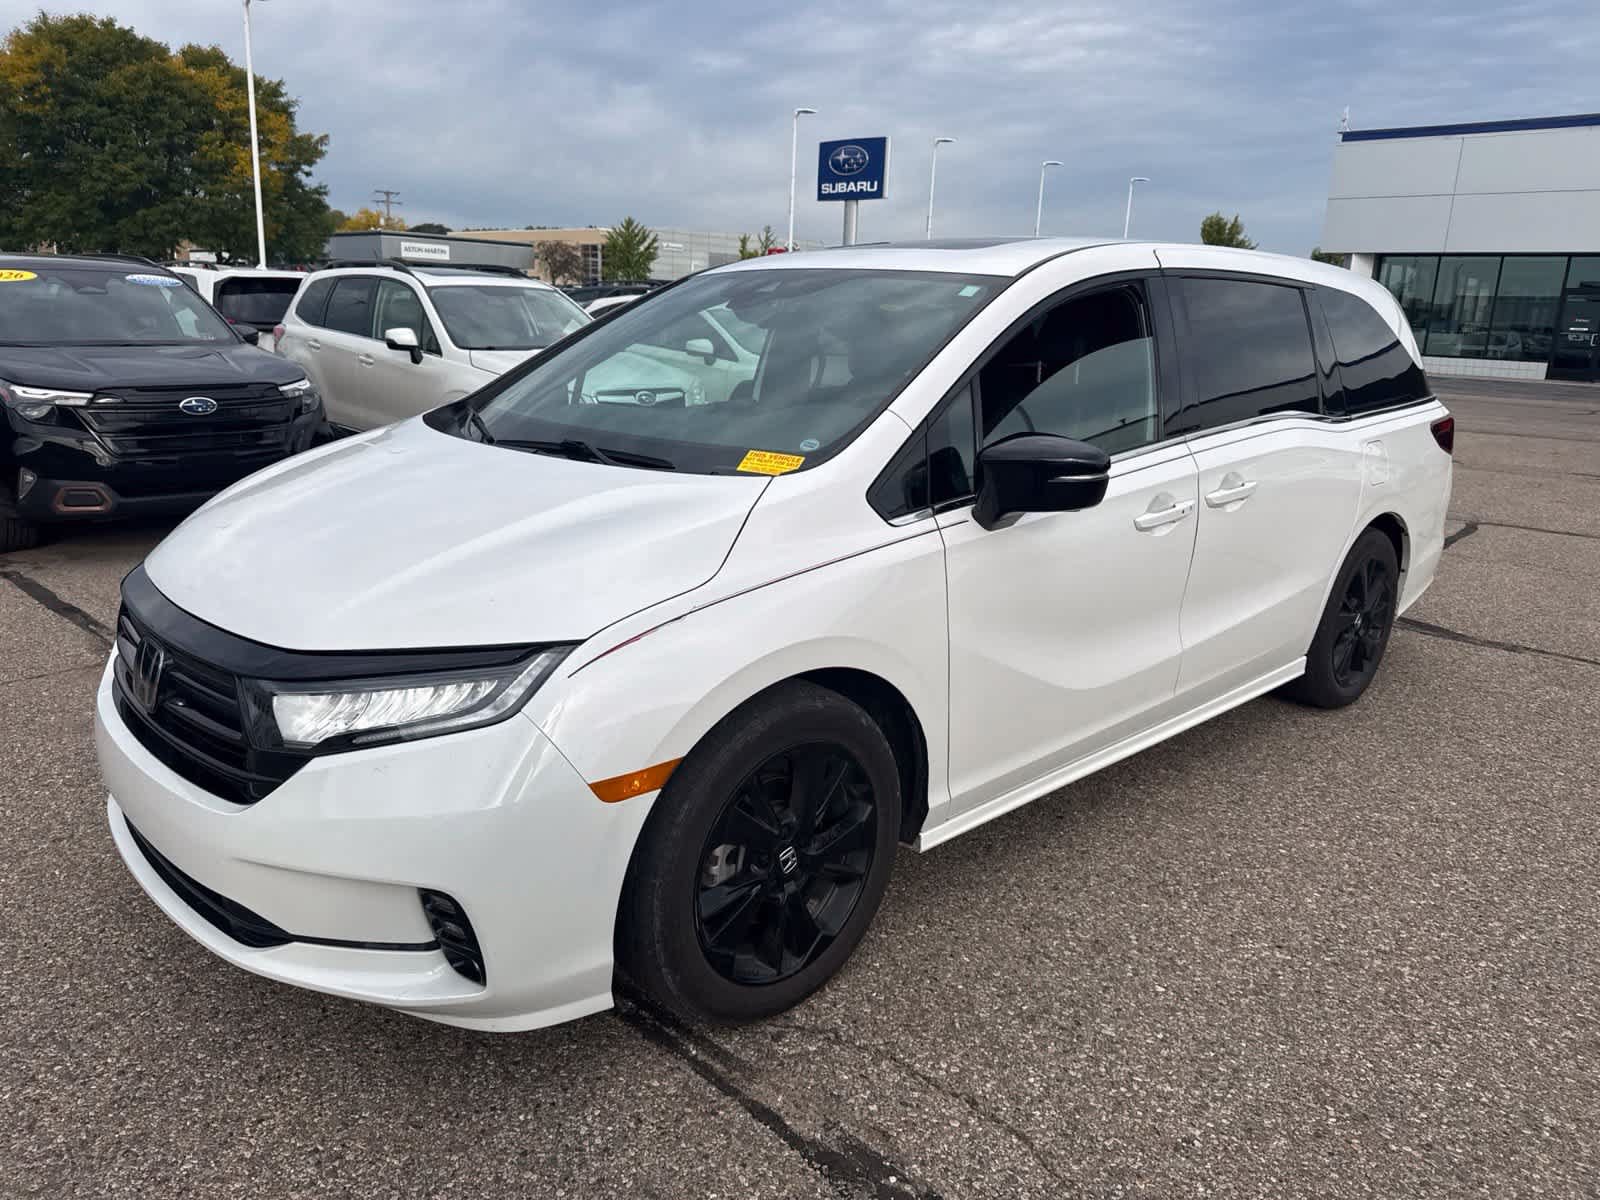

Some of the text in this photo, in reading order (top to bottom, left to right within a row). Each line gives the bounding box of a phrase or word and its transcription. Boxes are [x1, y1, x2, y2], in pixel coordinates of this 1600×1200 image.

[821, 181, 878, 194] SUBARU
[404, 245, 447, 255] ASTON MARTIN
[768, 454, 802, 463] VEHICLE
